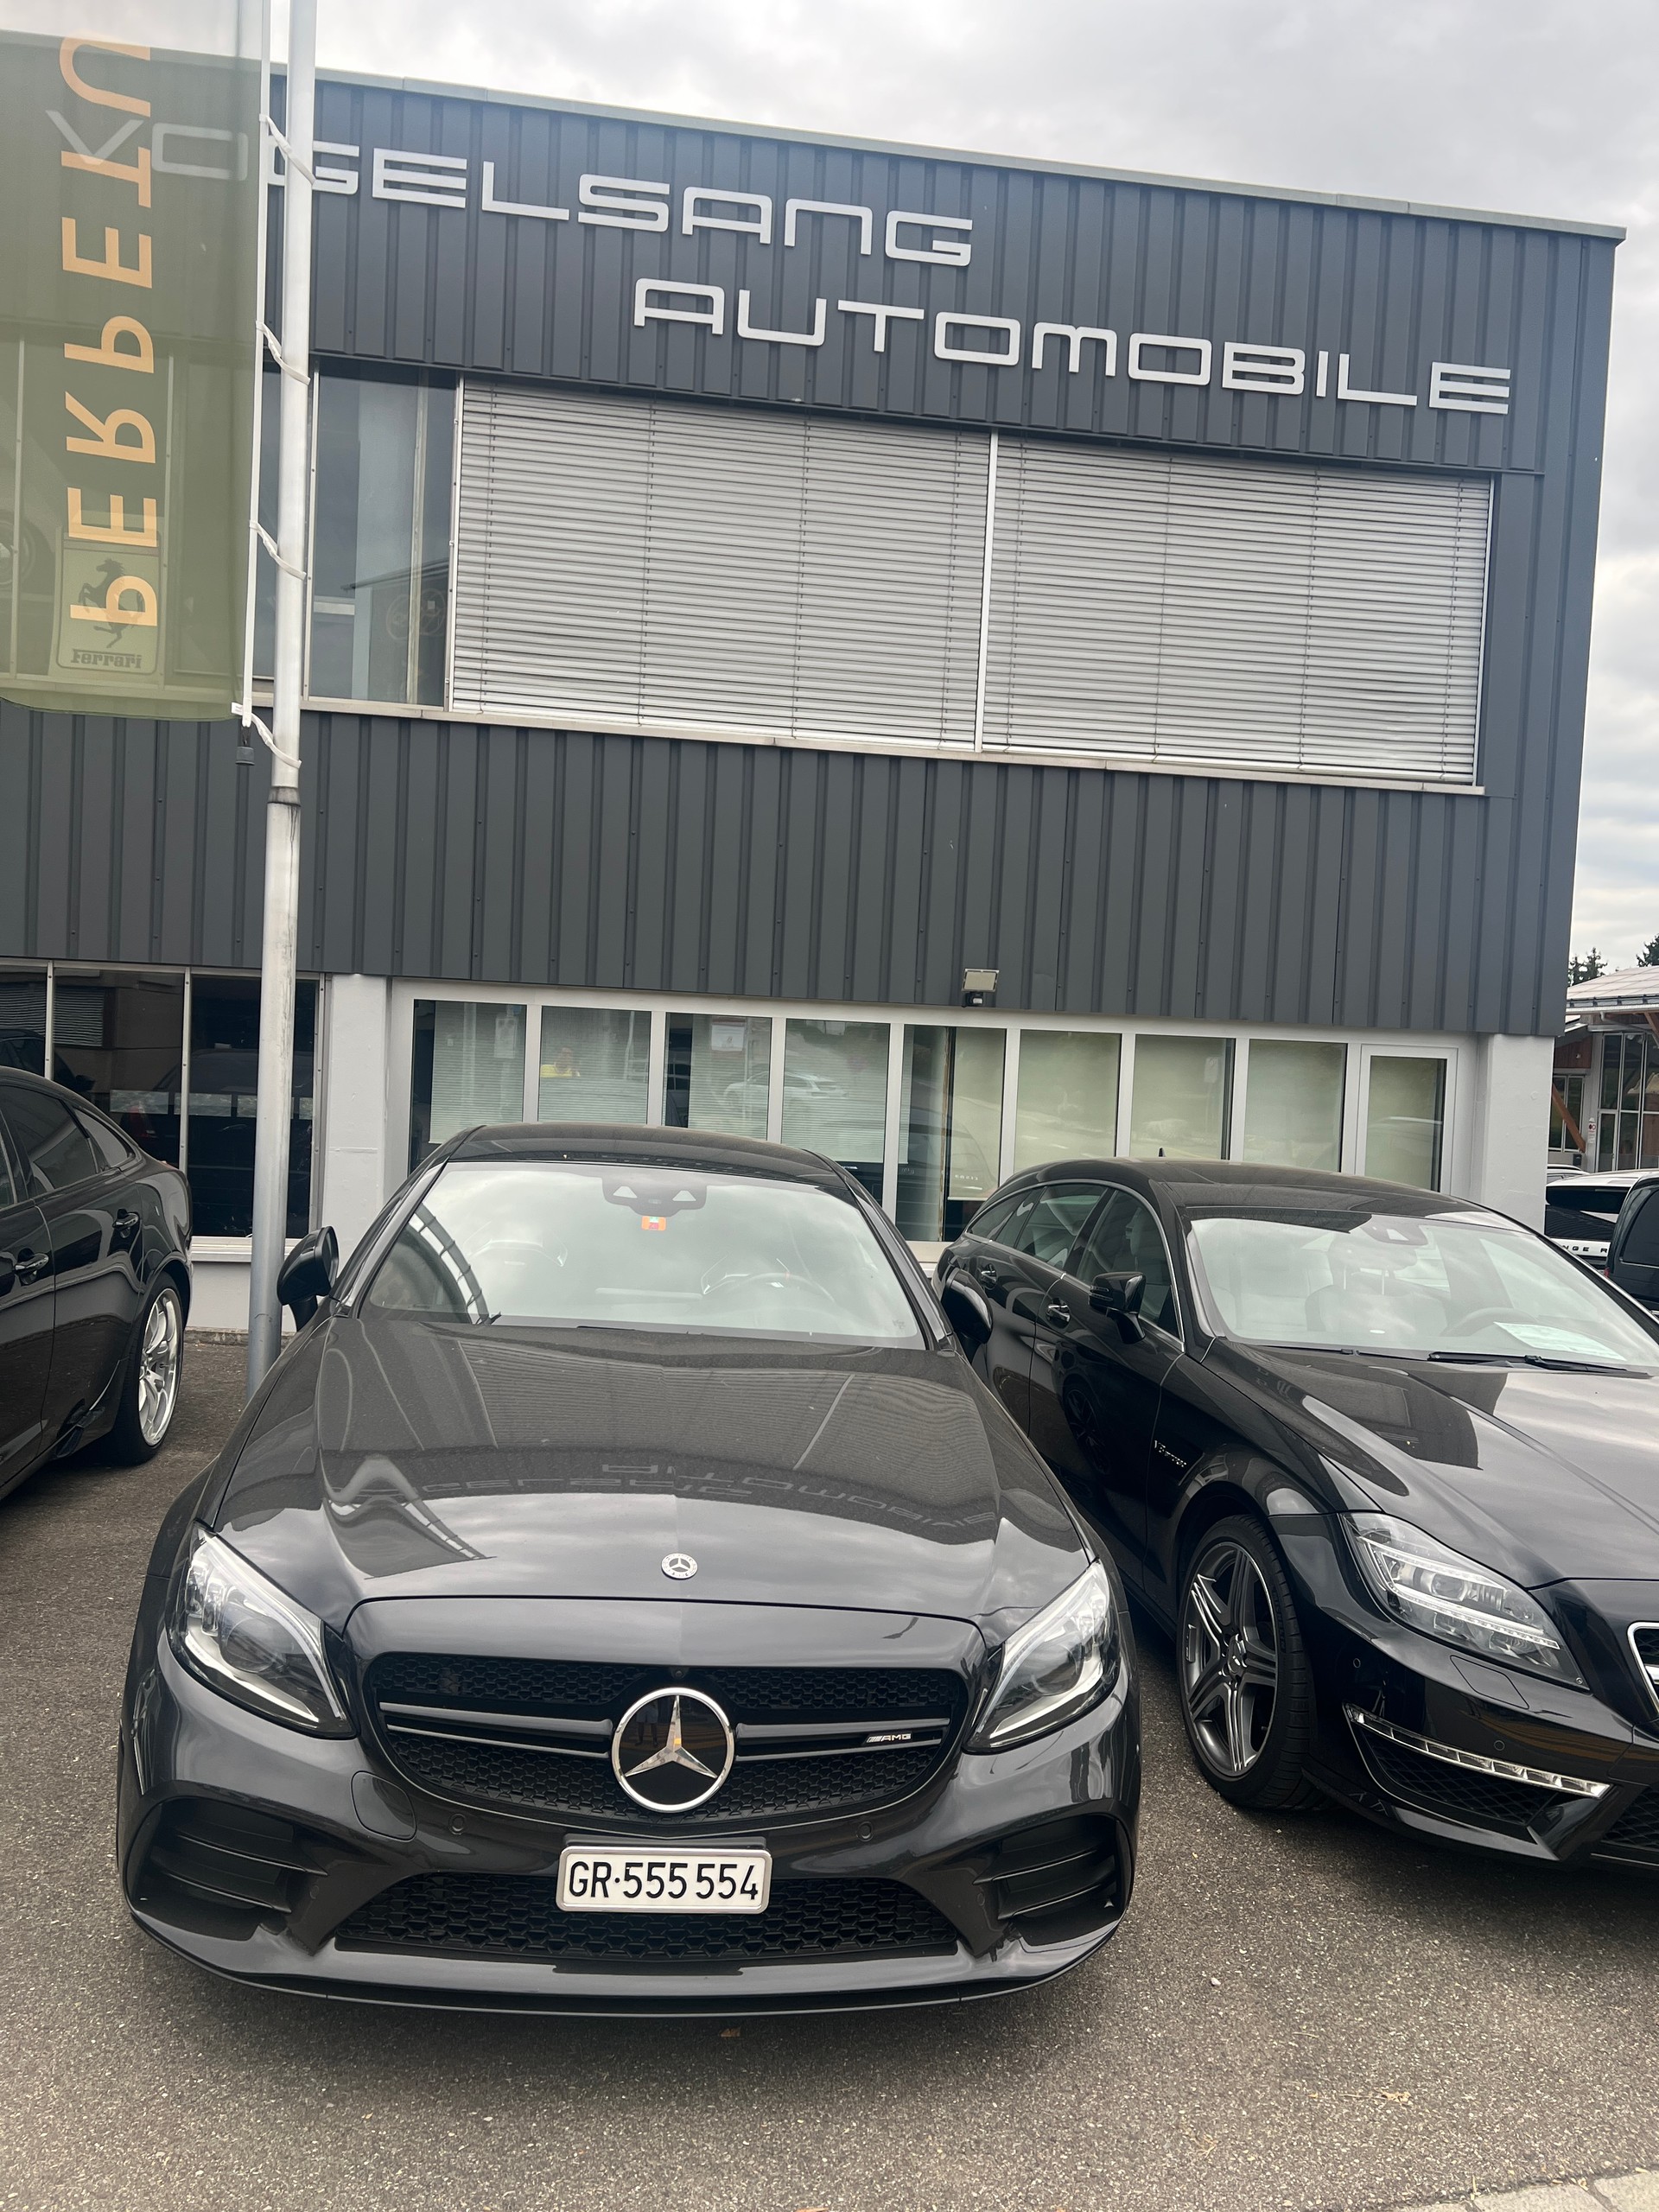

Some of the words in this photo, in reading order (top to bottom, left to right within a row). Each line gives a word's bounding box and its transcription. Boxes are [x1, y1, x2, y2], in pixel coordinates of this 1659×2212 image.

[634, 276, 1511, 415] AUTOMOBILE
[71, 649, 143, 669] Ferrari
[880, 1732, 912, 1742] AMG
